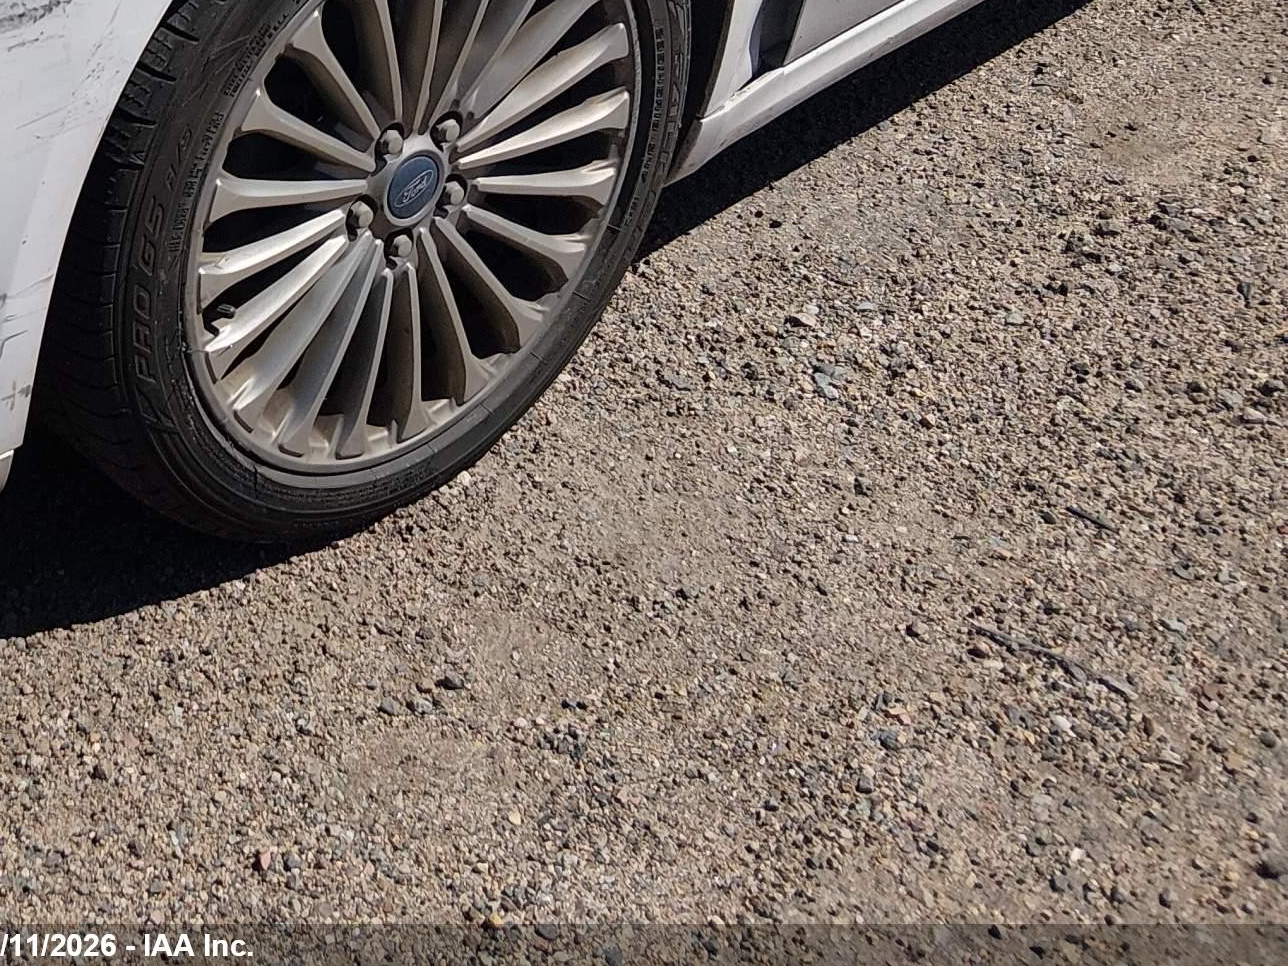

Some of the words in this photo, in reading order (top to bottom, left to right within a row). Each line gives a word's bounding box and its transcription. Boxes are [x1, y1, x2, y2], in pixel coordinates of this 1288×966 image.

[401, 175, 429, 203] Ford
[137, 195, 165, 277] G5
[133, 284, 157, 383] PRO
